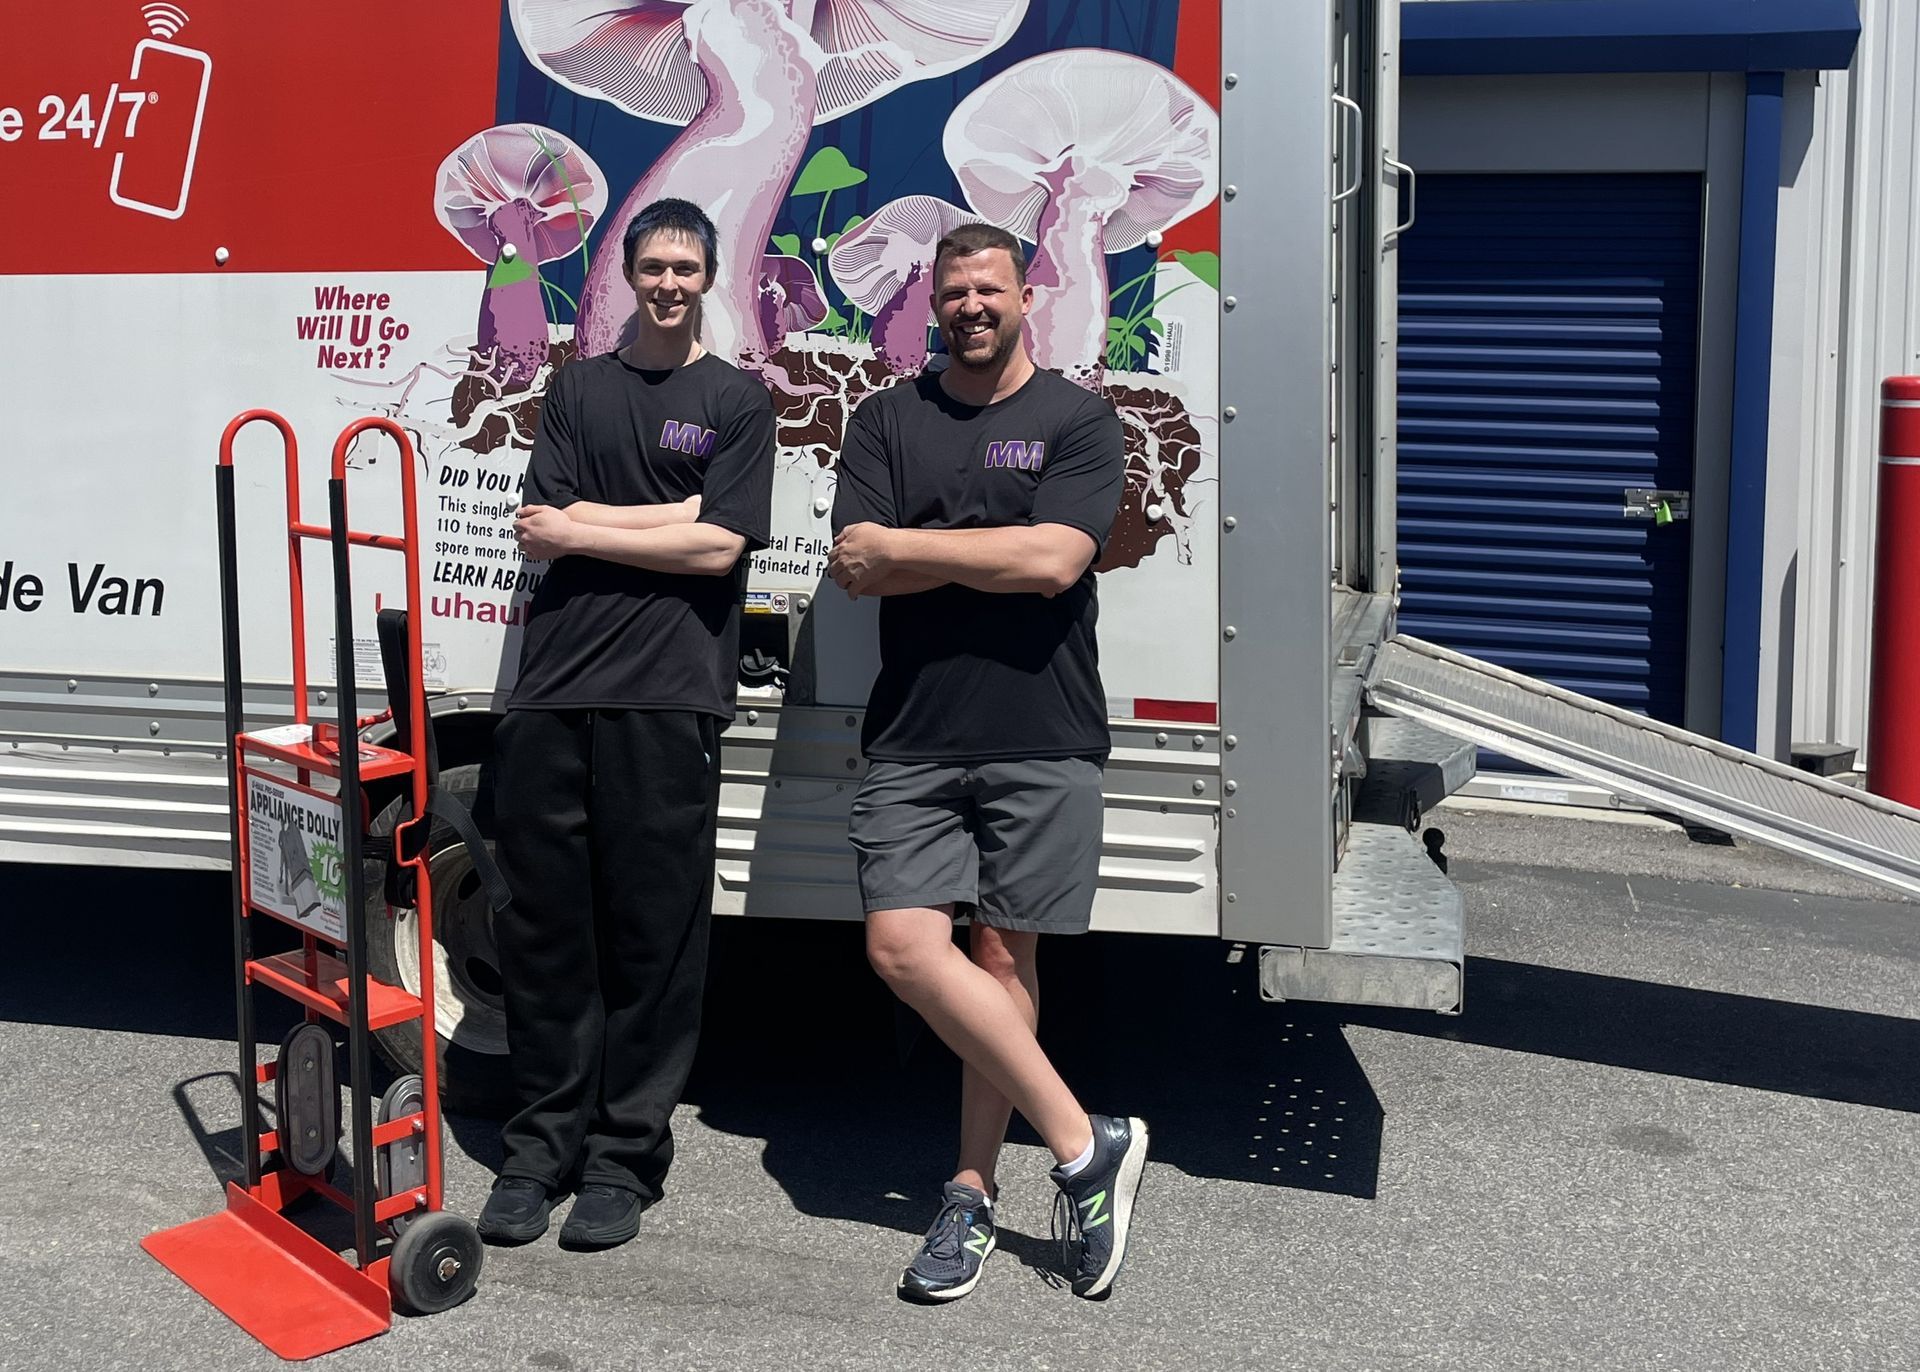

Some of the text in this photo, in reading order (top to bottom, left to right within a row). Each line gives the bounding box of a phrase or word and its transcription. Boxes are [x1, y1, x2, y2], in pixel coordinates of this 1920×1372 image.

[314, 285, 391, 310] Where
[296, 314, 410, 347] Will U Go
[317, 343, 391, 369] Next?
[659, 419, 718, 459] MM
[984, 440, 1045, 471] MM
[439, 465, 469, 487] DID
[476, 467, 511, 492] YOU
[438, 495, 466, 513] This
[472, 500, 510, 520] single
[437, 518, 460, 534] 110
[466, 521, 493, 538] tons
[435, 541, 469, 557] spore
[475, 545, 506, 560] more
[794, 536, 829, 557] Falls
[433, 560, 488, 588] LEARN
[741, 554, 810, 576] originated
[68, 562, 165, 616] Van
[250, 790, 305, 831] APPLIANCE
[306, 807, 341, 843] DOLLY
